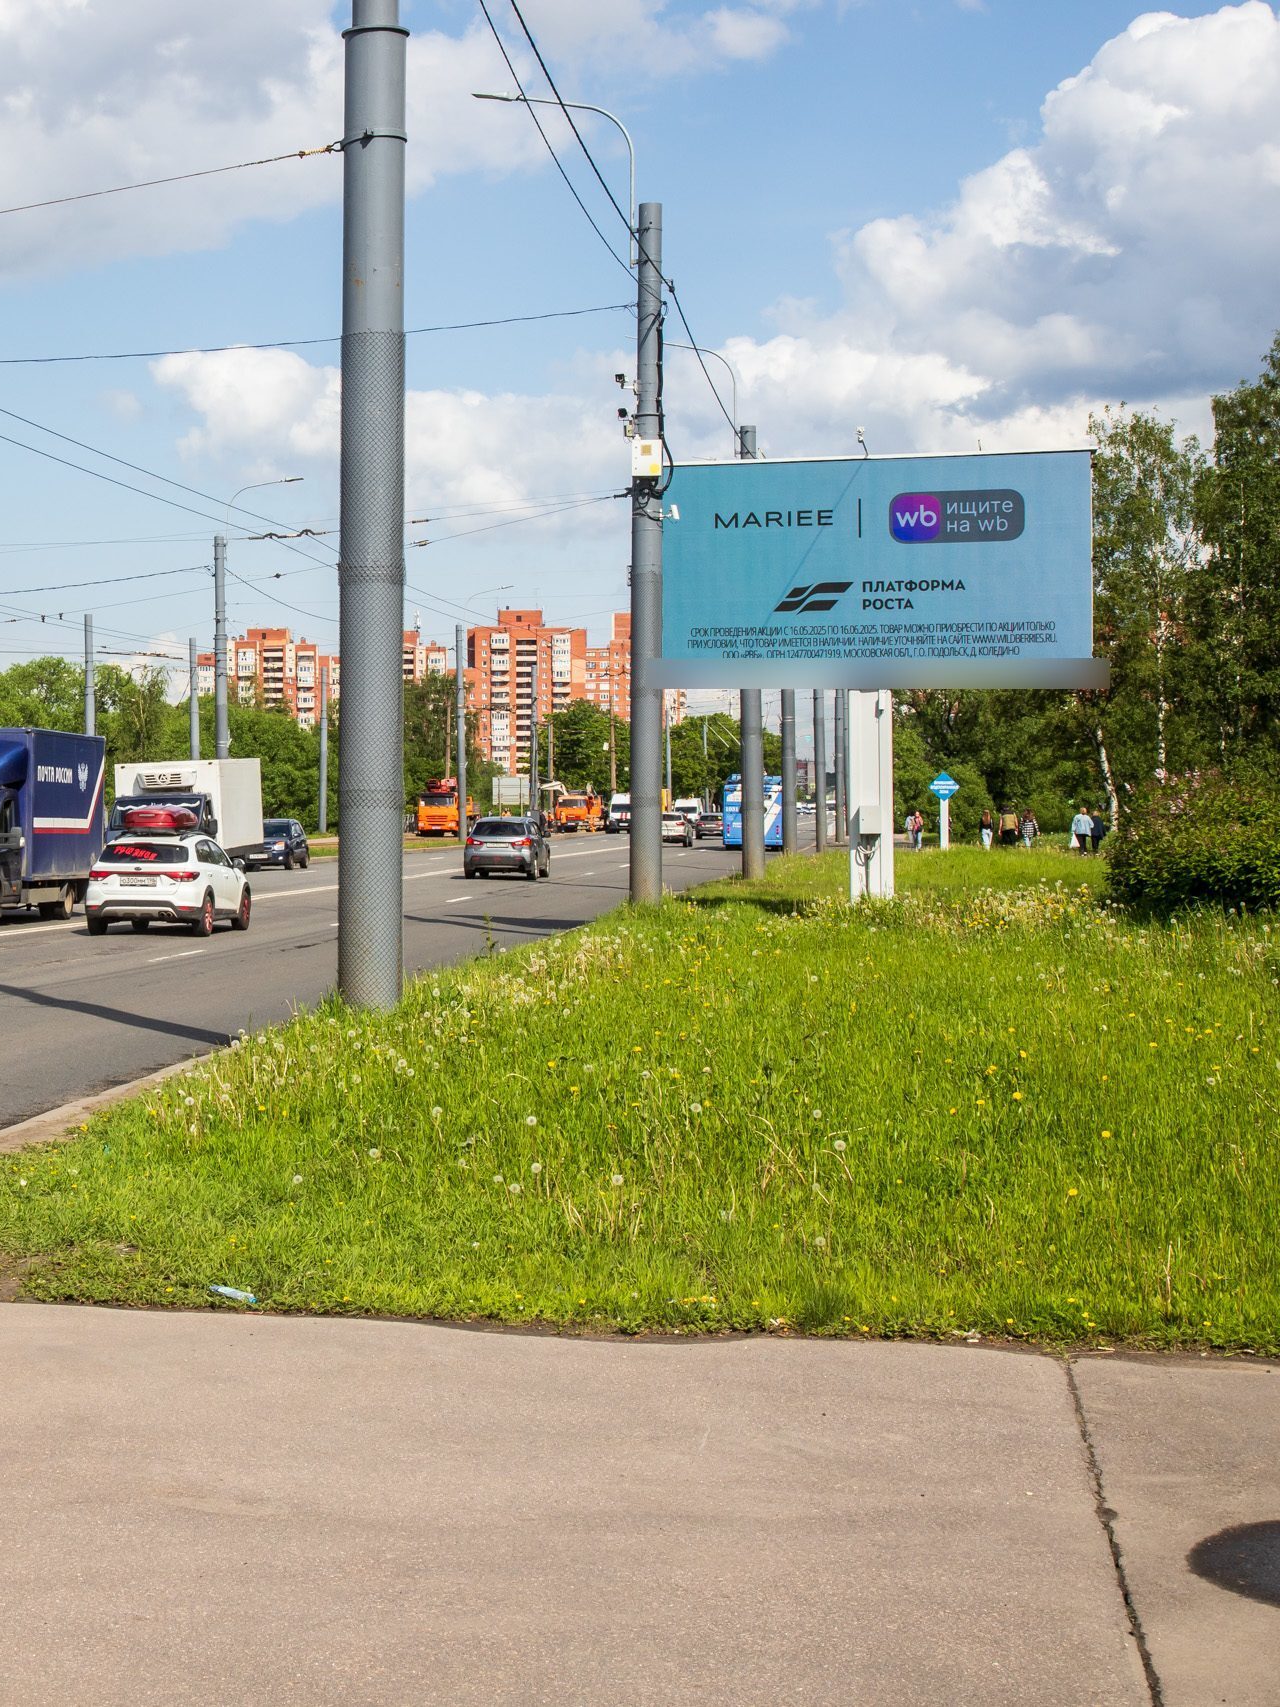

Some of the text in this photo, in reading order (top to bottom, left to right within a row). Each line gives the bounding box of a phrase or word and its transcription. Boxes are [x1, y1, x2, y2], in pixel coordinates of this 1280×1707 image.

[946, 499, 1014, 516] ищите
[715, 509, 834, 529] MARIEE
[895, 504, 938, 528] wb
[946, 516, 1009, 533] на wb
[862, 578, 966, 593] ПЛАТФОРМА
[862, 597, 914, 611] РОСТА
[691, 628, 709, 637] СРОК
[710, 627, 757, 637] ПРОВЕДЕНИЯ
[758, 627, 782, 637] АКЦИИ
[790, 626, 827, 635] 16.05.2025
[828, 626, 838, 635] ПО
[841, 625, 878, 635] 16.06.2025.
[880, 624, 903, 633] ТОВАР
[904, 623, 934, 632] МОЖНО
[936, 622, 985, 632] ПРИОБРЕСТИ
[986, 623, 998, 632] ПО
[998, 622, 1025, 633] АКЦИИ
[1026, 621, 1055, 631] ТОЛЬКО
[688, 640, 703, 648] ПРИ
[740, 639, 755, 648] ЧТО
[755, 638, 777, 647] ТОВАР
[778, 638, 812, 647] ИМЕЕТСЯ
[813, 638, 818, 647] В
[858, 636, 894, 646] НАЛИЧИЕ
[894, 634, 936, 645] УТОЧНЯЙТЕ
[937, 635, 948, 644] НА
[948, 634, 971, 644] САЙТЕ
[767, 650, 786, 658] ОГРН
[843, 648, 893, 658] МОСКОВСКАЯ
[979, 646, 1020, 657] КОЛЕДИНО
[37, 765, 73, 784] ПОЧТА РОССИИ
